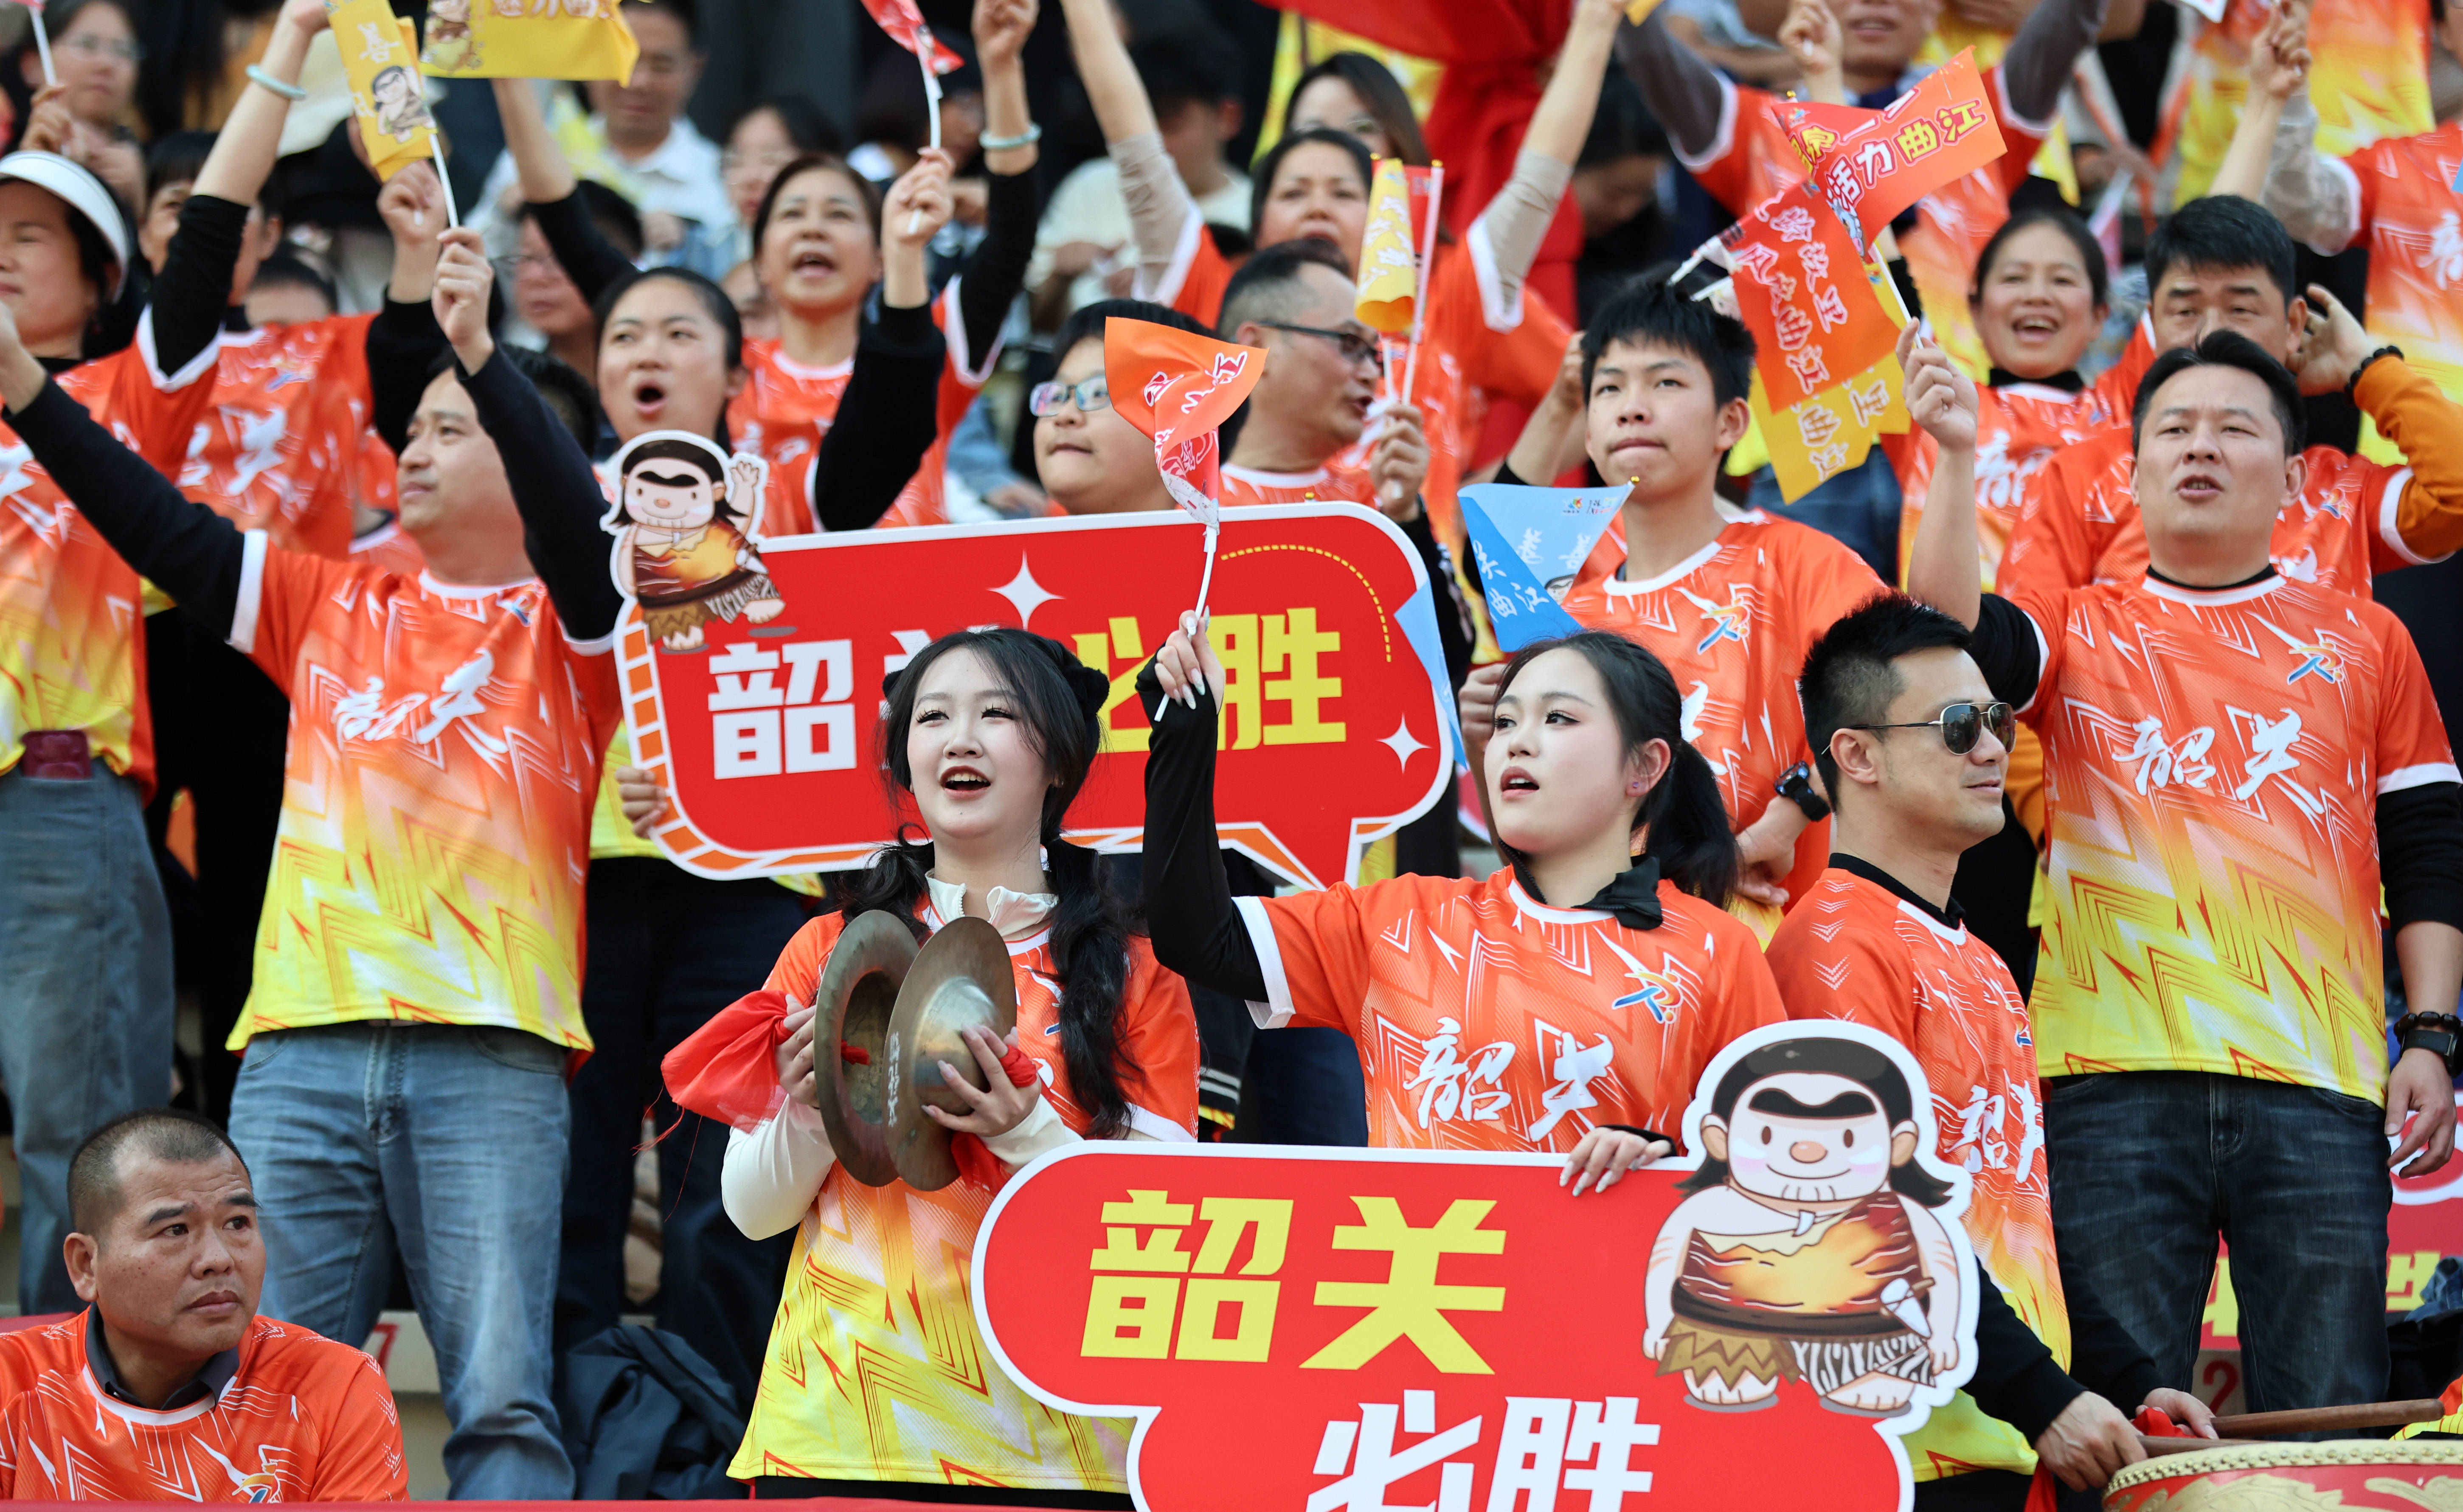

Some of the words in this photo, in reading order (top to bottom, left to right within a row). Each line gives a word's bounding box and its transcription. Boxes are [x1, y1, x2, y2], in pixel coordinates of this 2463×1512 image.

[1827, 99, 1986, 211] 活力曲江
[1790, 394, 1849, 482] 曲江
[708, 608, 1347, 779] 韶必胜
[1080, 1189, 1507, 1374] 韶关
[1306, 1389, 1661, 1512] 必胜
